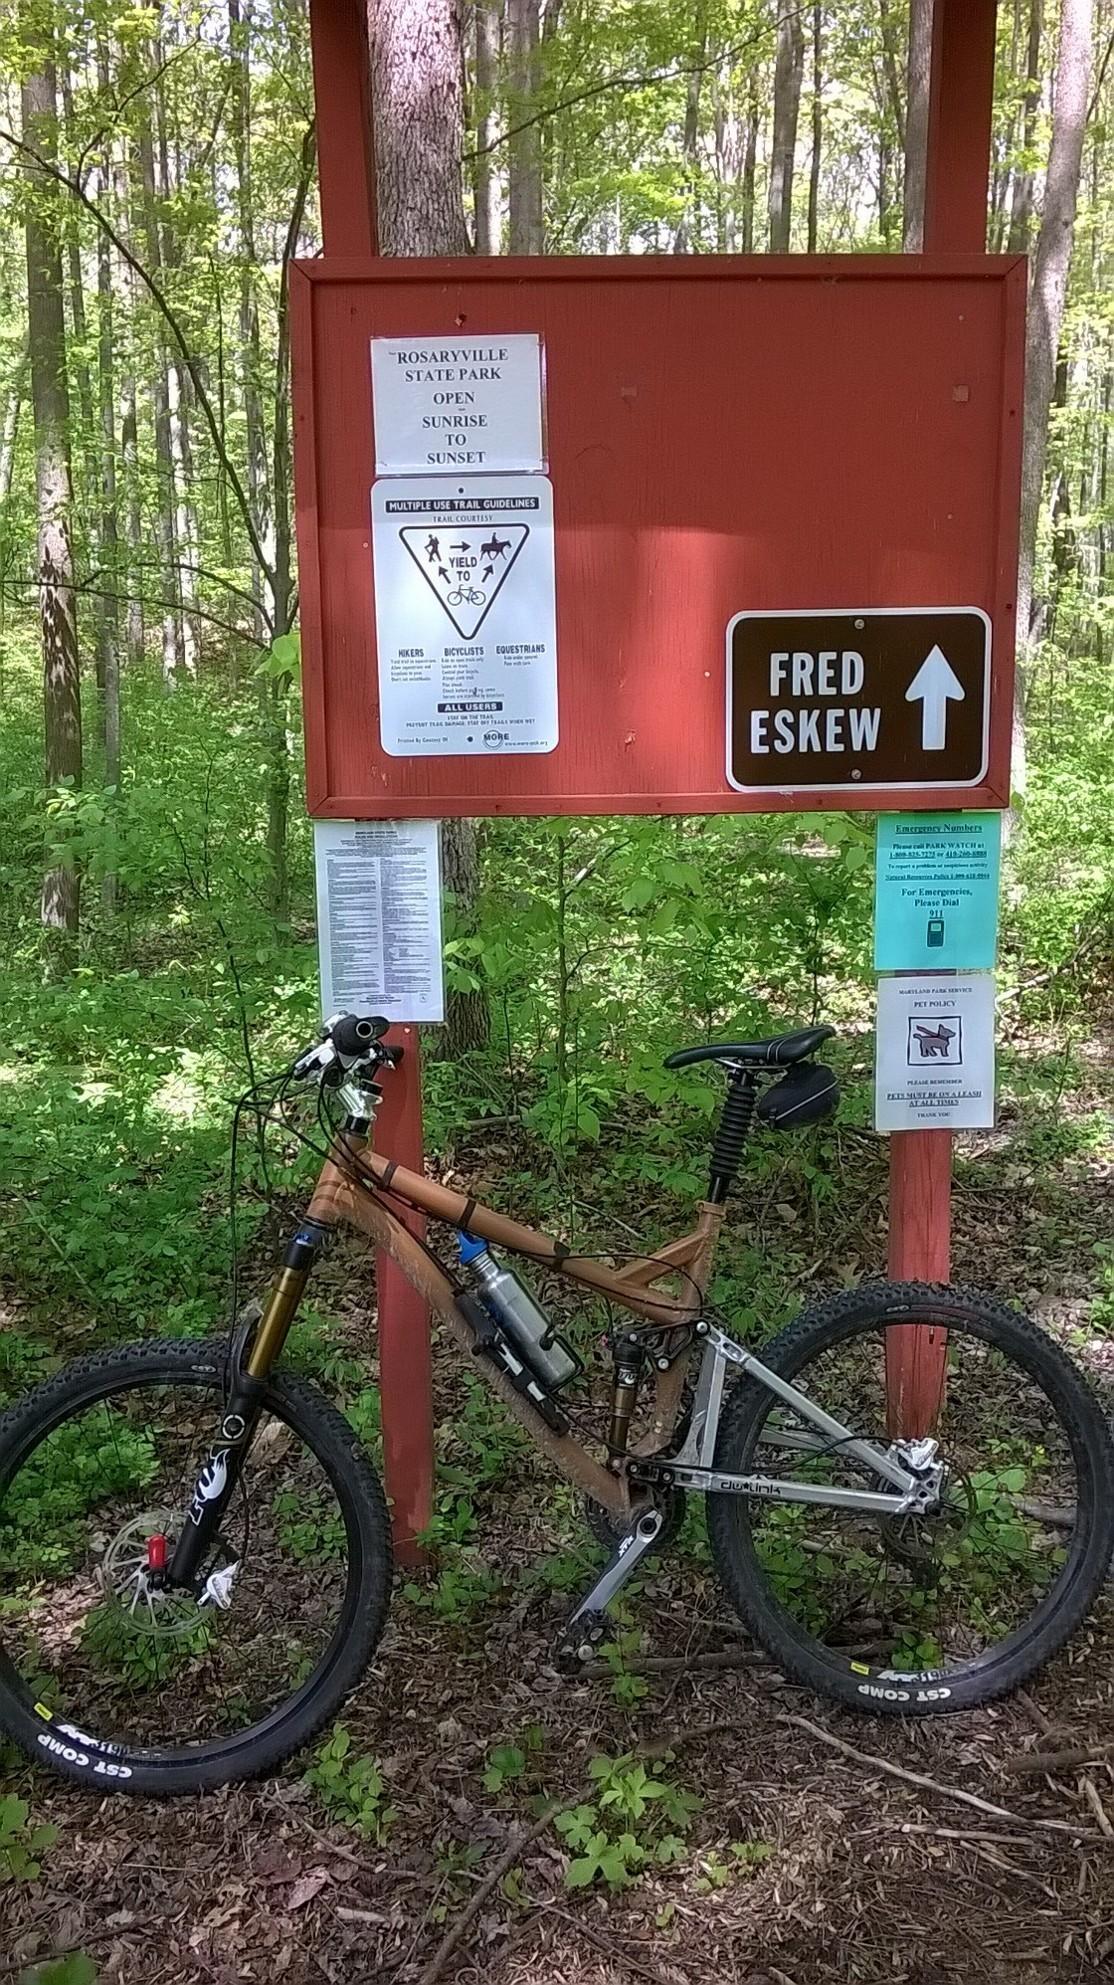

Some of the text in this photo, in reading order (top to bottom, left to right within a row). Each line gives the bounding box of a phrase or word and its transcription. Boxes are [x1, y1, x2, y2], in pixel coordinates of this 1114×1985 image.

[398, 349, 508, 364] ROSARYVILLE
[405, 367, 502, 382] STATE PARK
[433, 392, 475, 404] OPEN
[422, 415, 488, 428] SUNRISE
[445, 434, 467, 446] TO
[427, 451, 486, 464] SUNSET
[389, 499, 536, 511] MULTIPLE USE TRAIL GUIDELINES
[449, 556, 478, 568] YIELD
[457, 570, 471, 581] TO
[398, 648, 425, 658] HIKERS
[444, 647, 484, 656] BICYCLISTS
[496, 644, 546, 654] EQUESTRIANS
[769, 651, 865, 697] FRED
[444, 702, 497, 712] ALL USERS
[750, 707, 881, 754] ESKEW
[483, 733, 509, 741] MORE
[895, 823, 982, 835] Emergency Numbers
[901, 887, 973, 897] For Emergencies,
[914, 898, 960, 907] Please Dial
[929, 909, 944, 919] 911
[887, 1092, 905, 1100] PETS
[906, 1091, 927, 1100] MUST
[928, 1091, 938, 1099] BE
[939, 1091, 950, 1099] ON
[957, 1090, 982, 1098] LEASH
[909, 1100, 918, 1108] AT
[857, 1684, 952, 1702] CST COMP
[37, 1733, 90, 1766] COMP
[93, 1760, 133, 1778] CST
